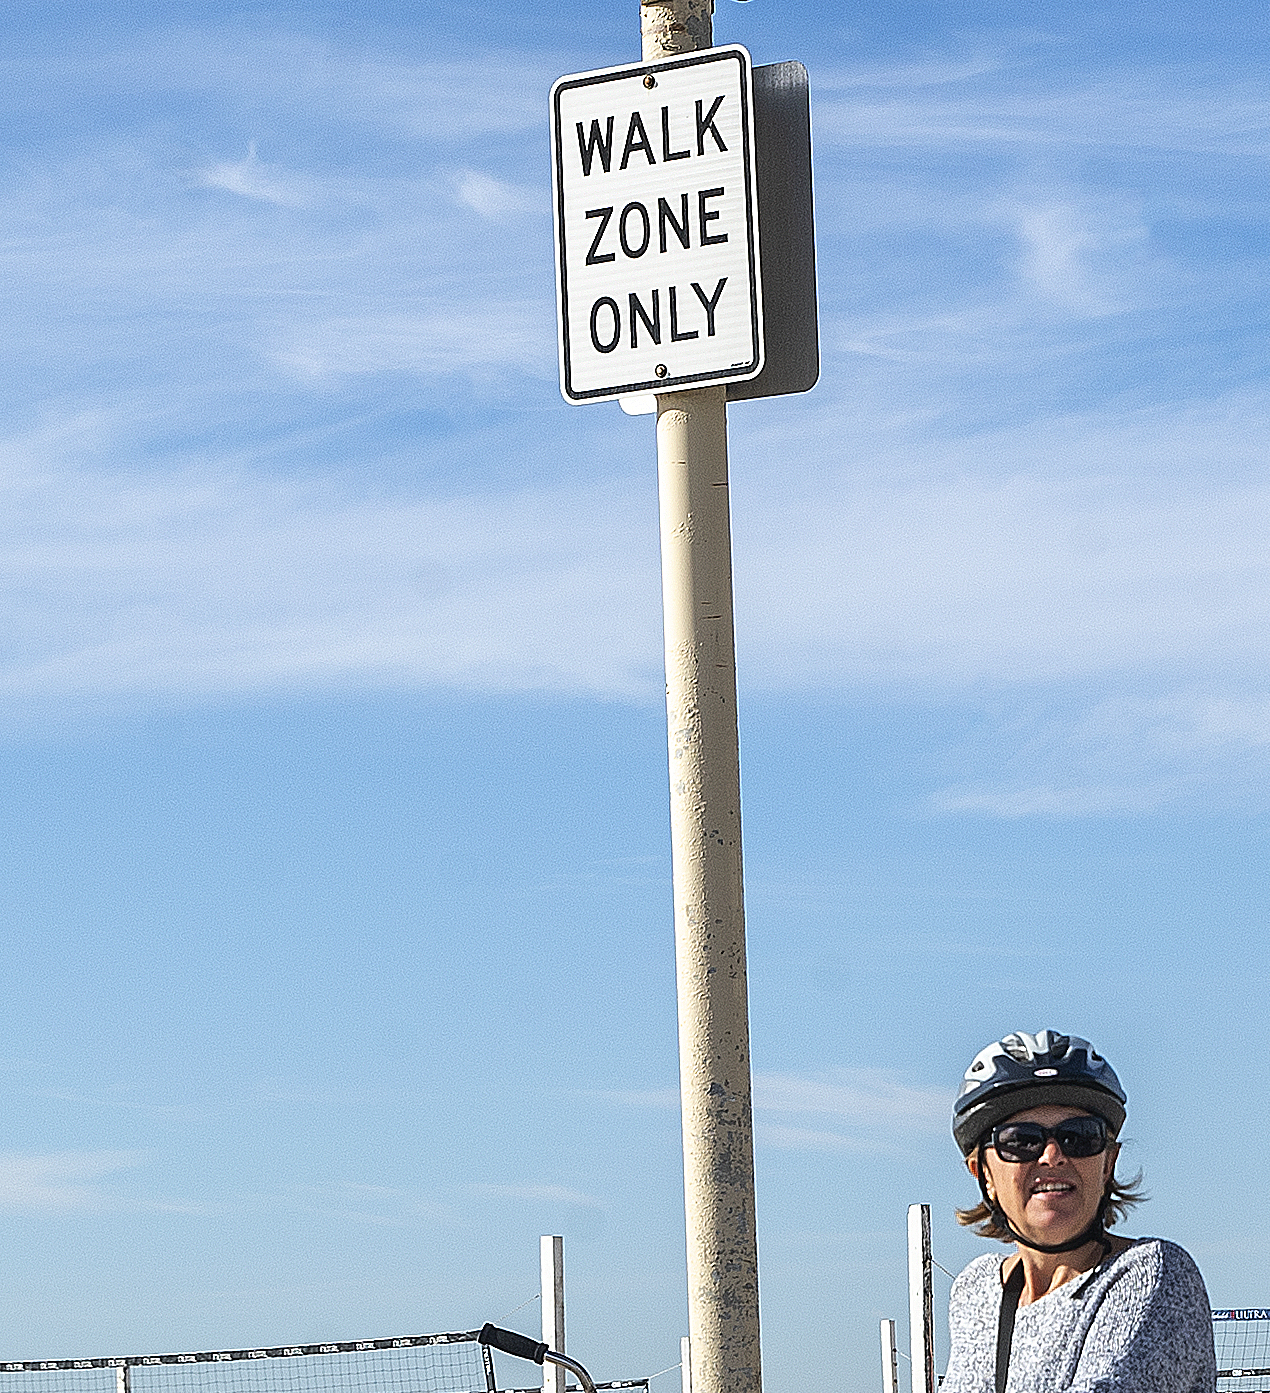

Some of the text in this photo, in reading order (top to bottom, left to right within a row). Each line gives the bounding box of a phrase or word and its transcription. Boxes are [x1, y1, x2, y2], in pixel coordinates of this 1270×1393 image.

[576, 95, 728, 176] WALK
[585, 187, 728, 266] ZONE
[590, 277, 728, 353] ONLY
